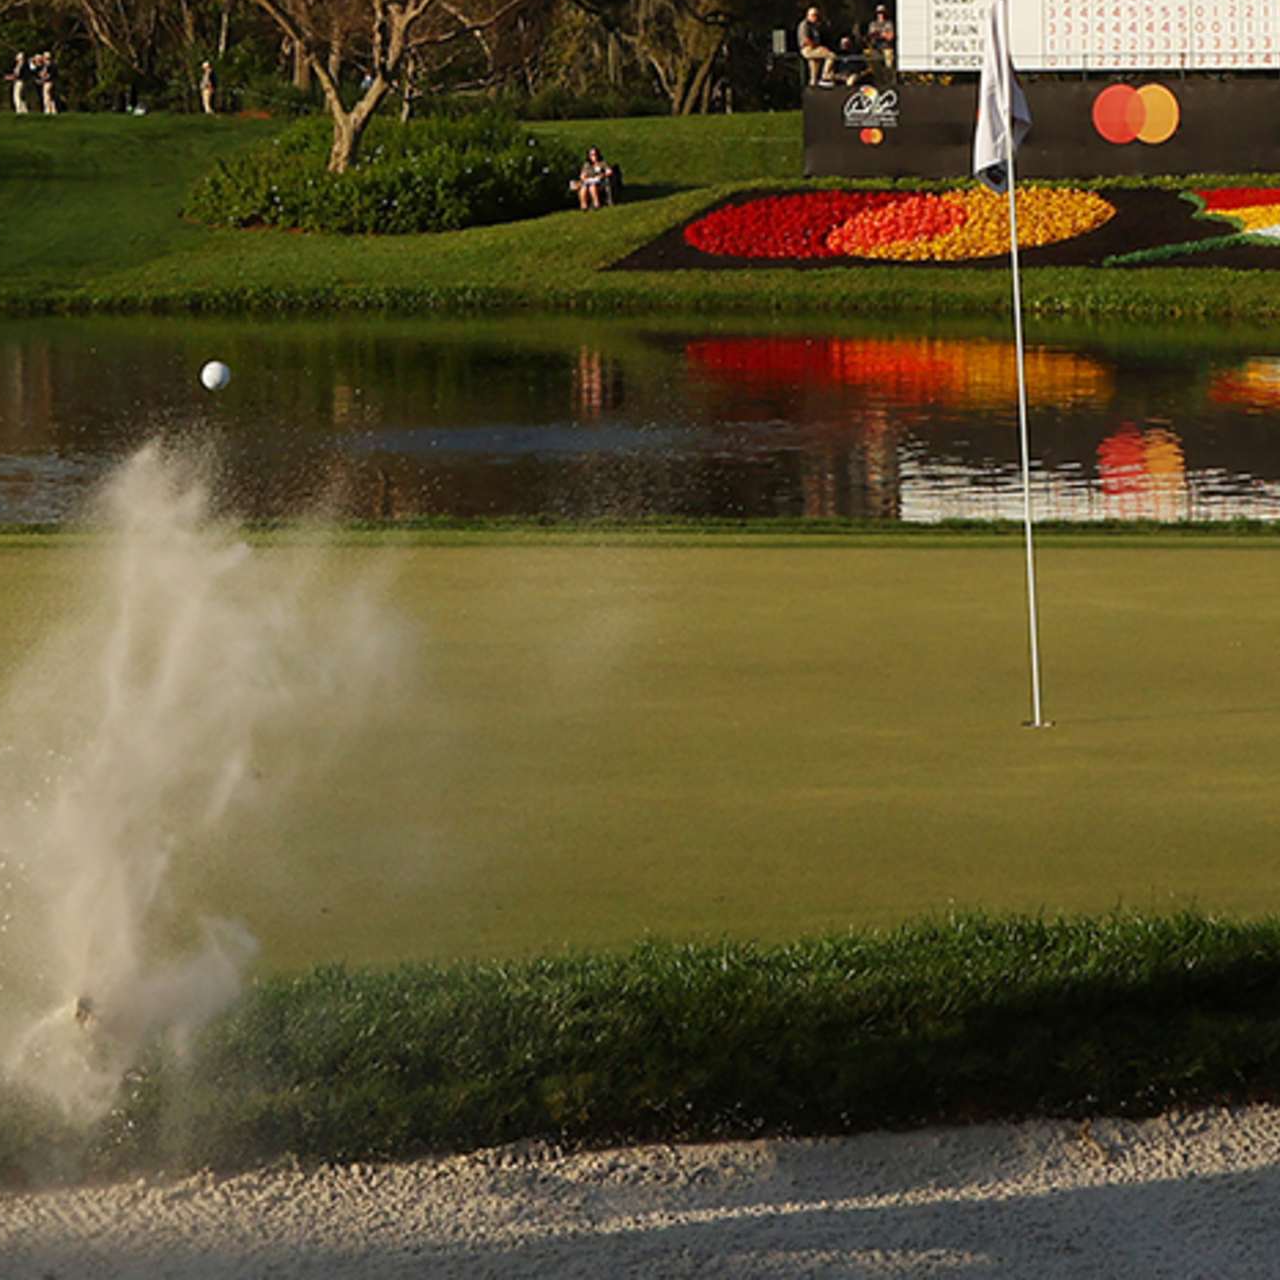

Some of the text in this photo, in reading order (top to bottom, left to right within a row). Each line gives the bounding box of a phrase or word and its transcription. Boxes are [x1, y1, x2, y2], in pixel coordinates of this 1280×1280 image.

[935, 8, 984, 21] HOSSLE
[934, 24, 978, 36] SPAUN
[934, 40, 984, 52] POULTE
